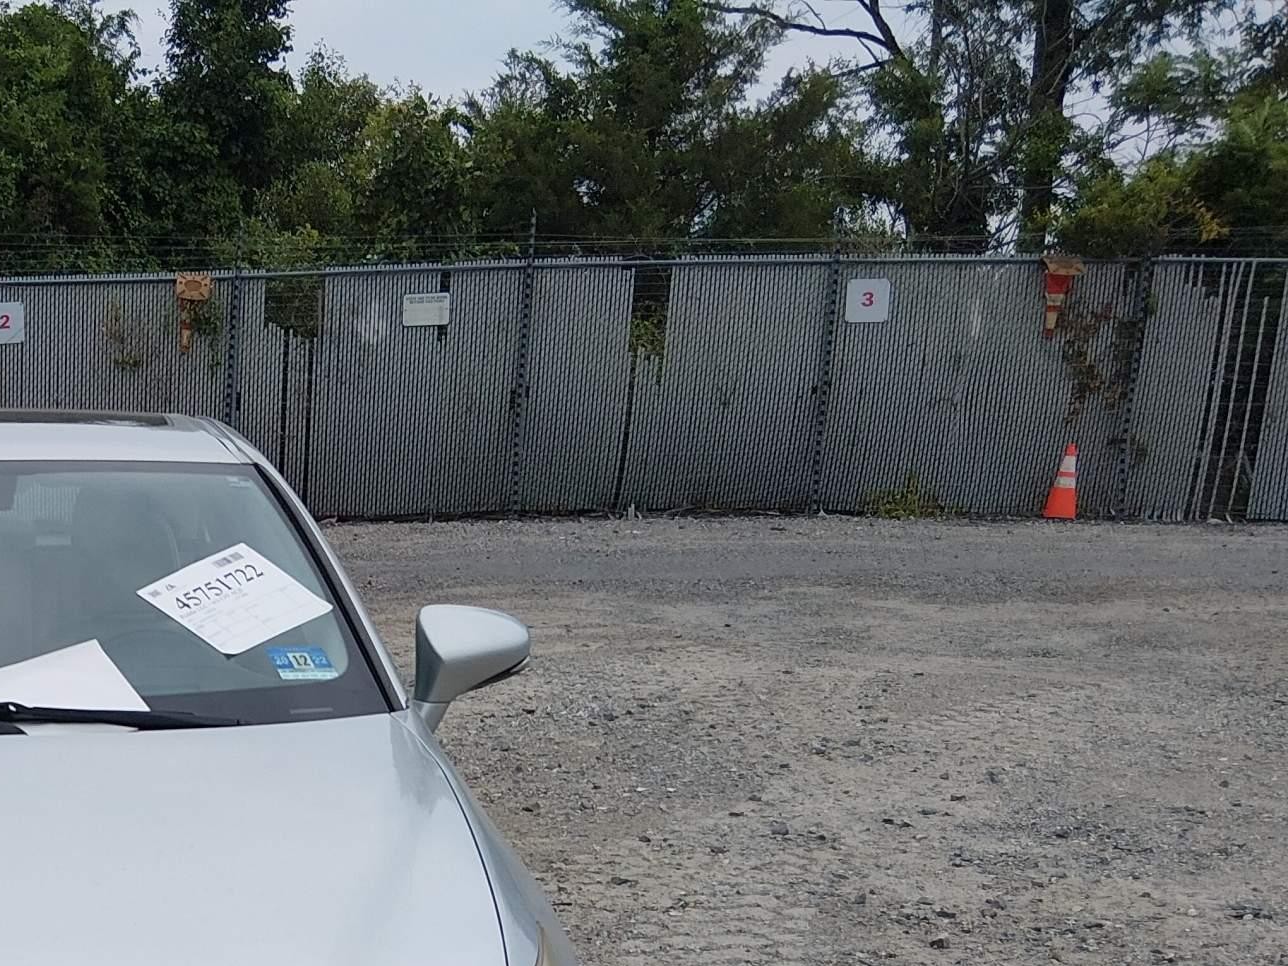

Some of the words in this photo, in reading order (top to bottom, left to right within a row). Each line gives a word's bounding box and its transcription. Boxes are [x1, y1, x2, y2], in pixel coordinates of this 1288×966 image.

[861, 292, 874, 307] 3
[0, 314, 11, 329] 2
[175, 564, 264, 609] 45751722
[292, 654, 311, 667] 12
